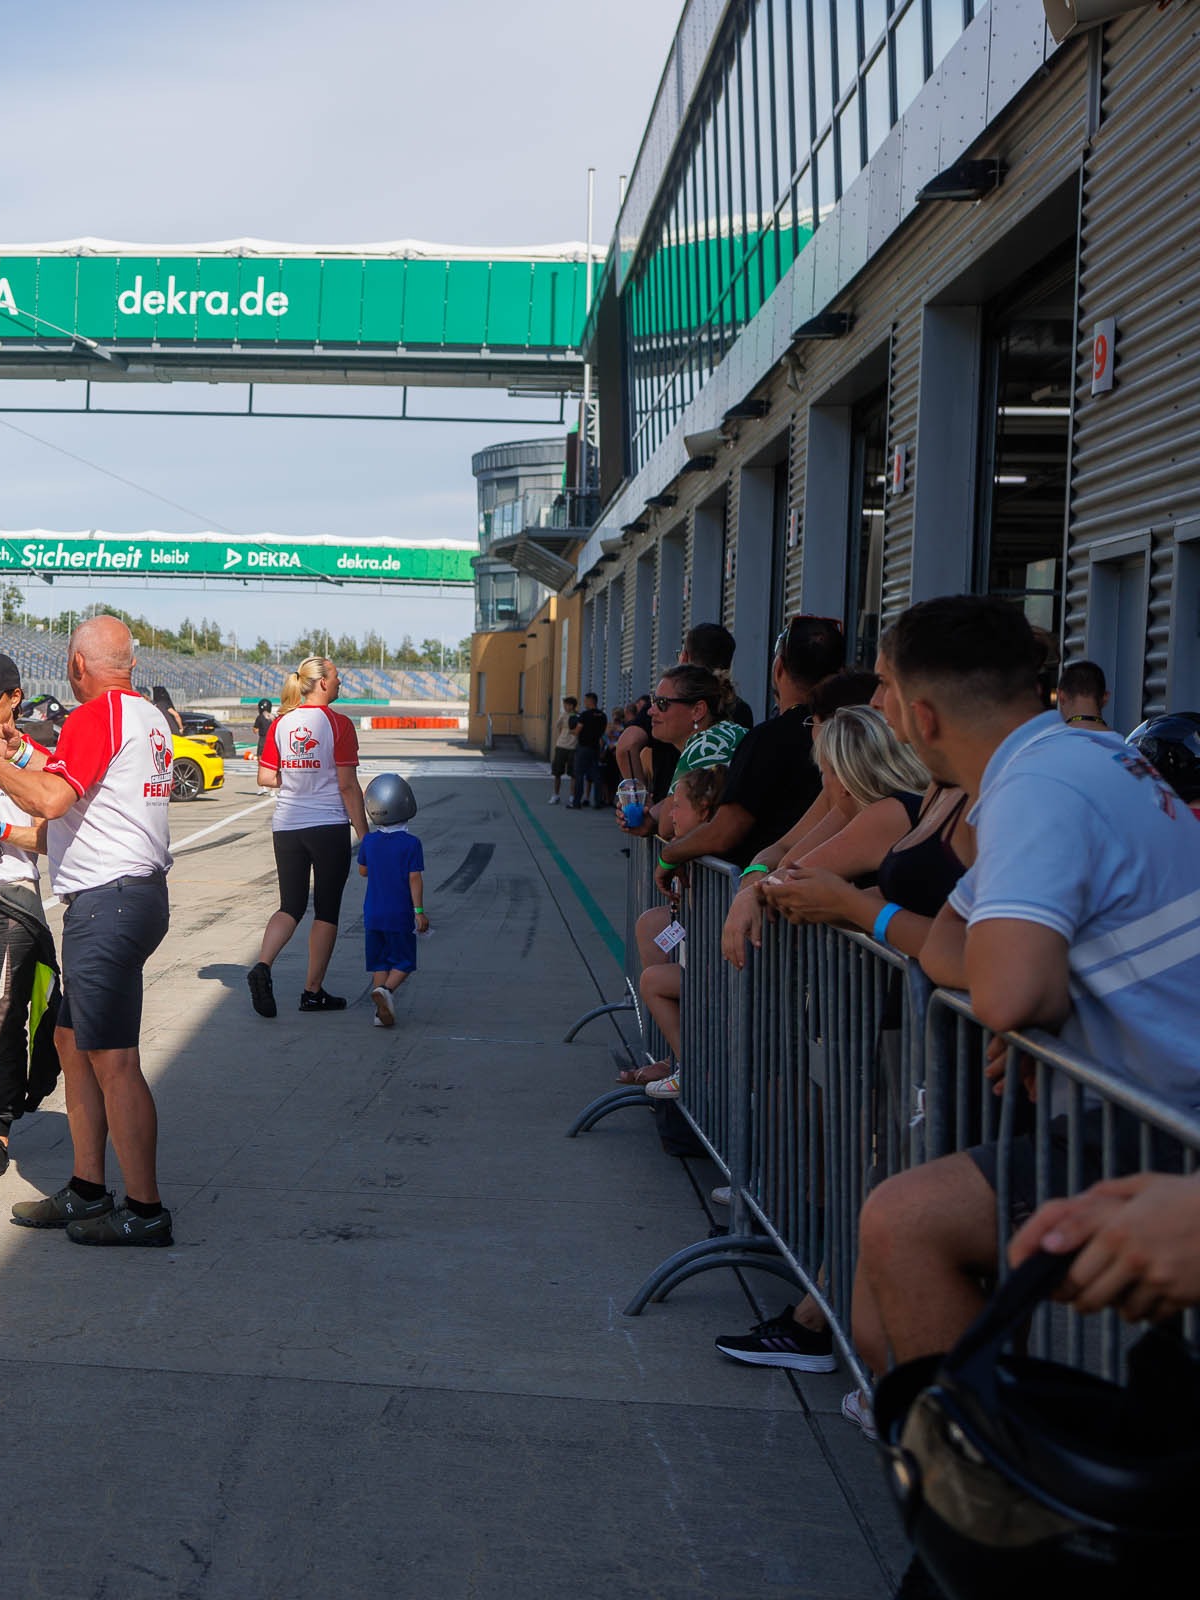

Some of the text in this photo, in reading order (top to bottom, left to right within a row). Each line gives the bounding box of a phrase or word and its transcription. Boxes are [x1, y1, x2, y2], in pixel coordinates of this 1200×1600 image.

[117, 275, 289, 316] dekra.de
[1095, 334, 1107, 380] 9
[21, 543, 143, 568] Sicherheit
[151, 548, 190, 564] bleibt
[247, 552, 302, 568] DEKRA
[337, 553, 401, 571] dekra.de
[281, 759, 321, 769] FEELING
